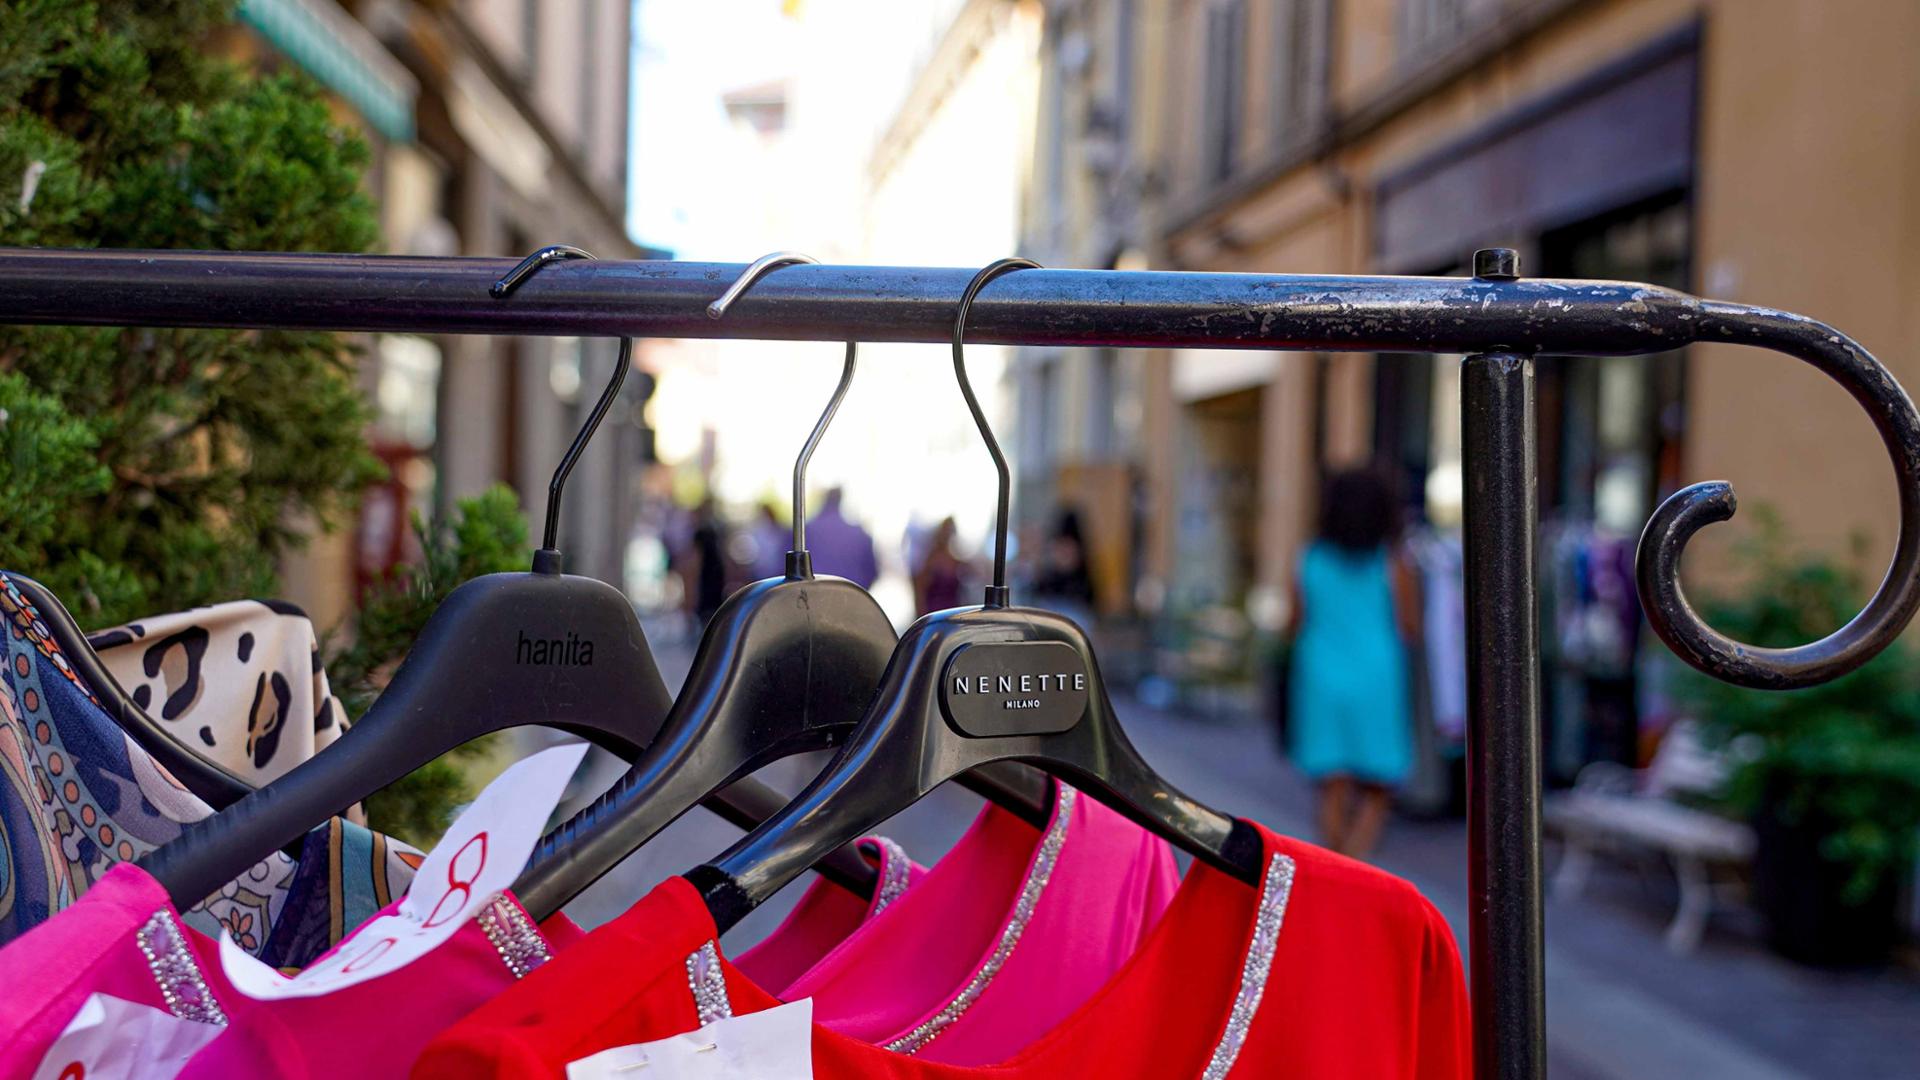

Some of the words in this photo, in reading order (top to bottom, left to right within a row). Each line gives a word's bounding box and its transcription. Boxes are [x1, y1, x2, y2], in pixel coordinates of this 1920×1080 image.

[516, 629, 594, 666] hanita
[954, 673, 1085, 694] NENETTE
[1004, 699, 1041, 710] MILANO
